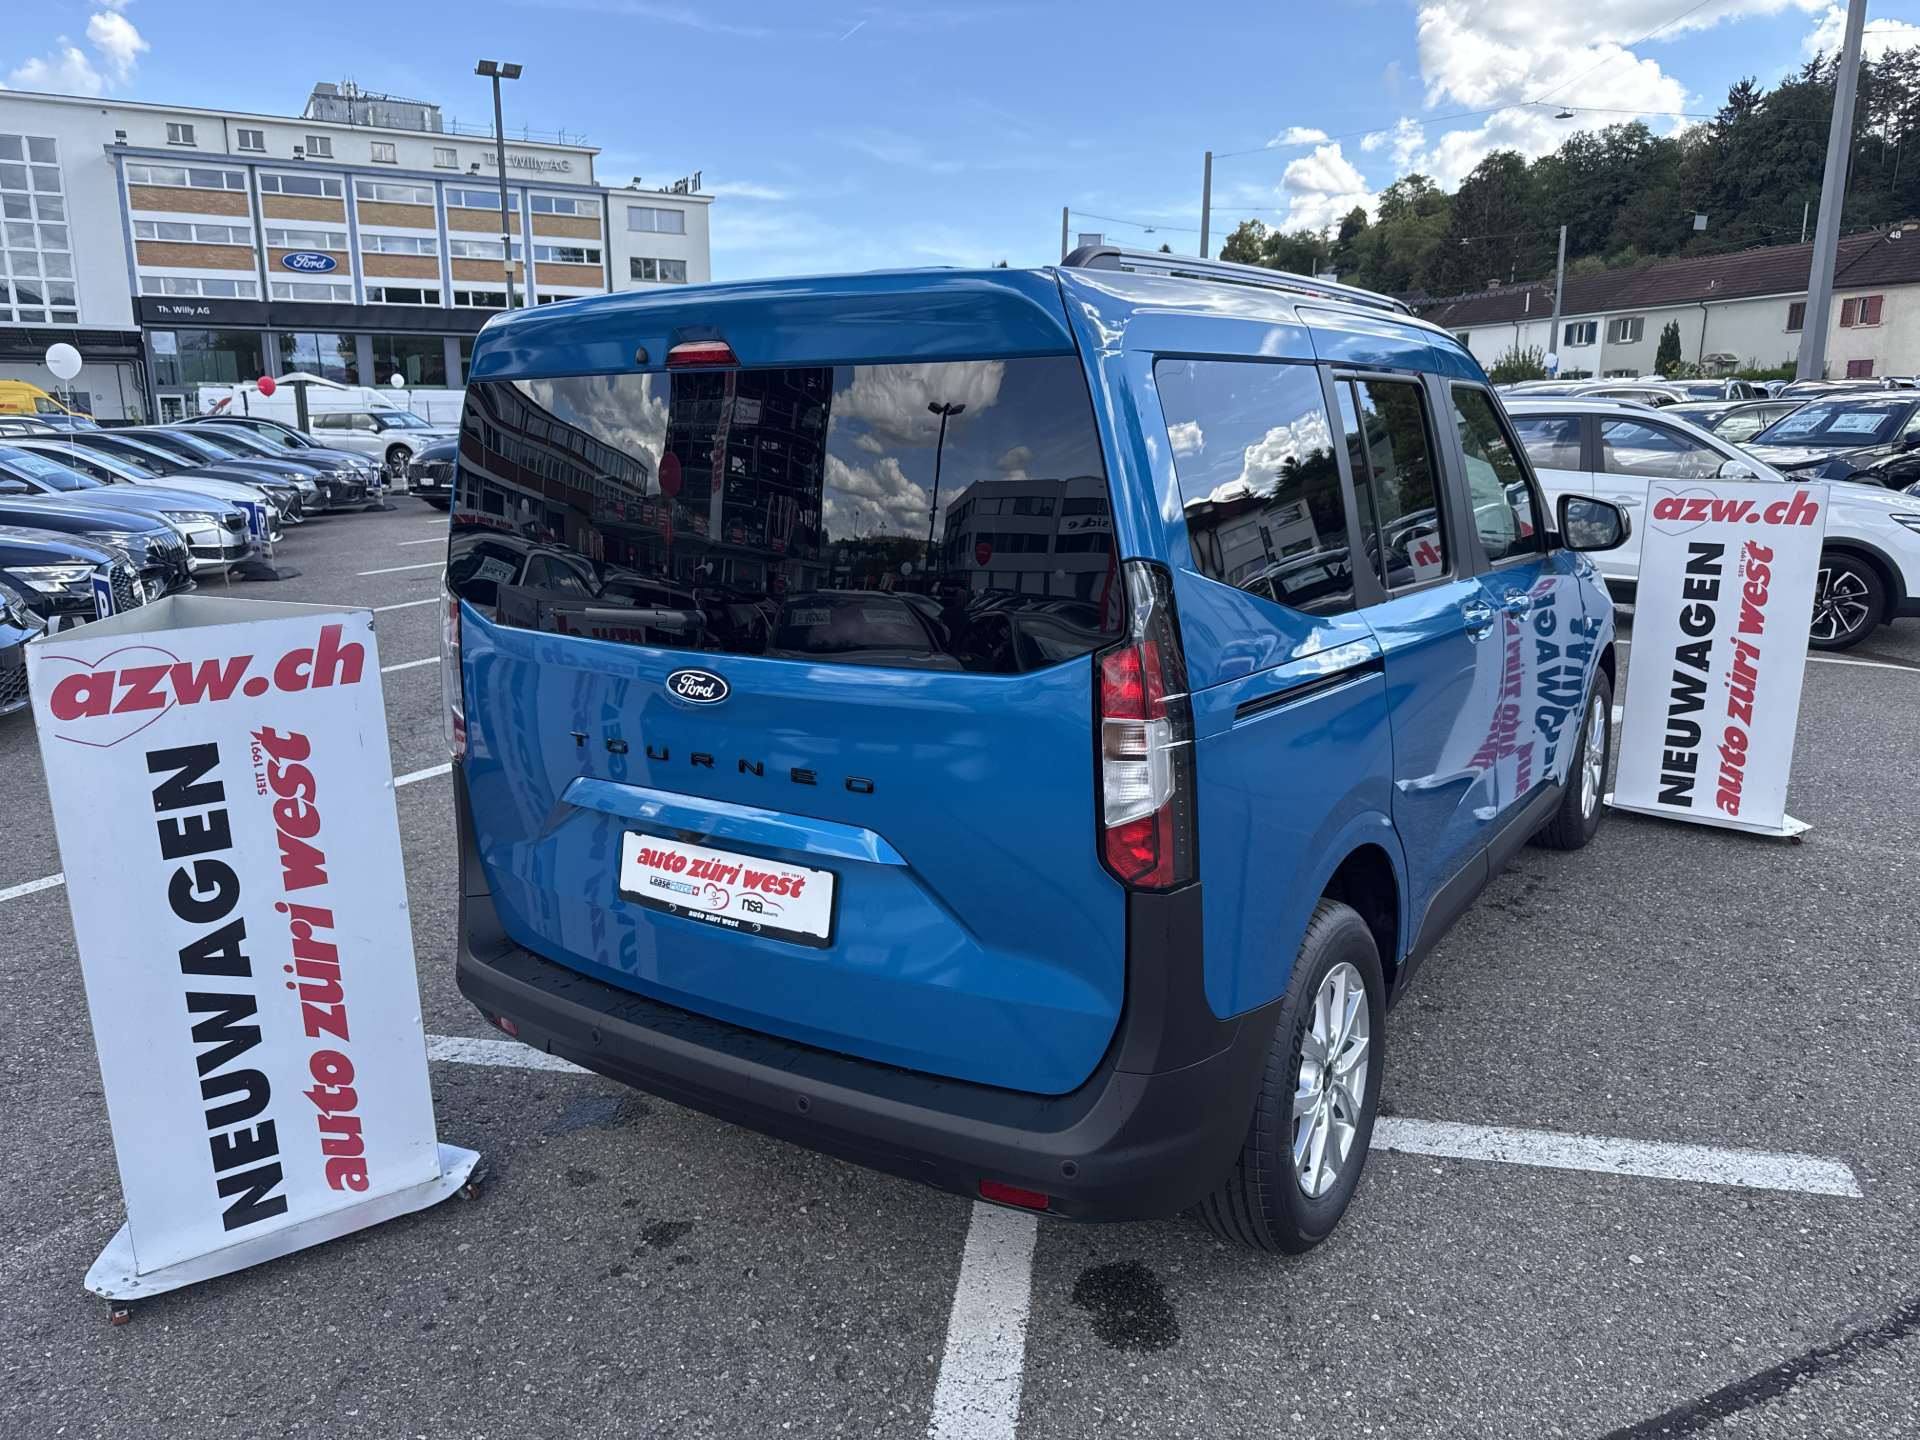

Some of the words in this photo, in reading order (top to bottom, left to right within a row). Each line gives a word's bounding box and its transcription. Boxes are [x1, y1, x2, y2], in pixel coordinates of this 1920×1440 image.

[511, 154, 546, 172] Willy
[549, 160, 572, 172] AG
[157, 305, 171, 314] Th.
[173, 306, 195, 316] Willy
[197, 306, 211, 315] AG
[1653, 490, 1820, 526] azw.ch
[1738, 540, 1774, 635] west
[50, 624, 365, 721] azw.ch
[1657, 541, 1726, 808] NEUWAGEN
[1724, 636, 1761, 727] züri
[252, 740, 262, 768] 1991
[256, 771, 268, 796] SEIT
[570, 730, 875, 794] TOURNEO
[1715, 725, 1749, 816] auto
[250, 725, 329, 892] west
[637, 847, 687, 873] auto
[686, 857, 743, 885] züri
[742, 871, 806, 898] west
[742, 898, 763, 914] nsa
[145, 742, 289, 1233] NEUWAGEN
[274, 901, 351, 1043] züri
[302, 1049, 370, 1192] auto
